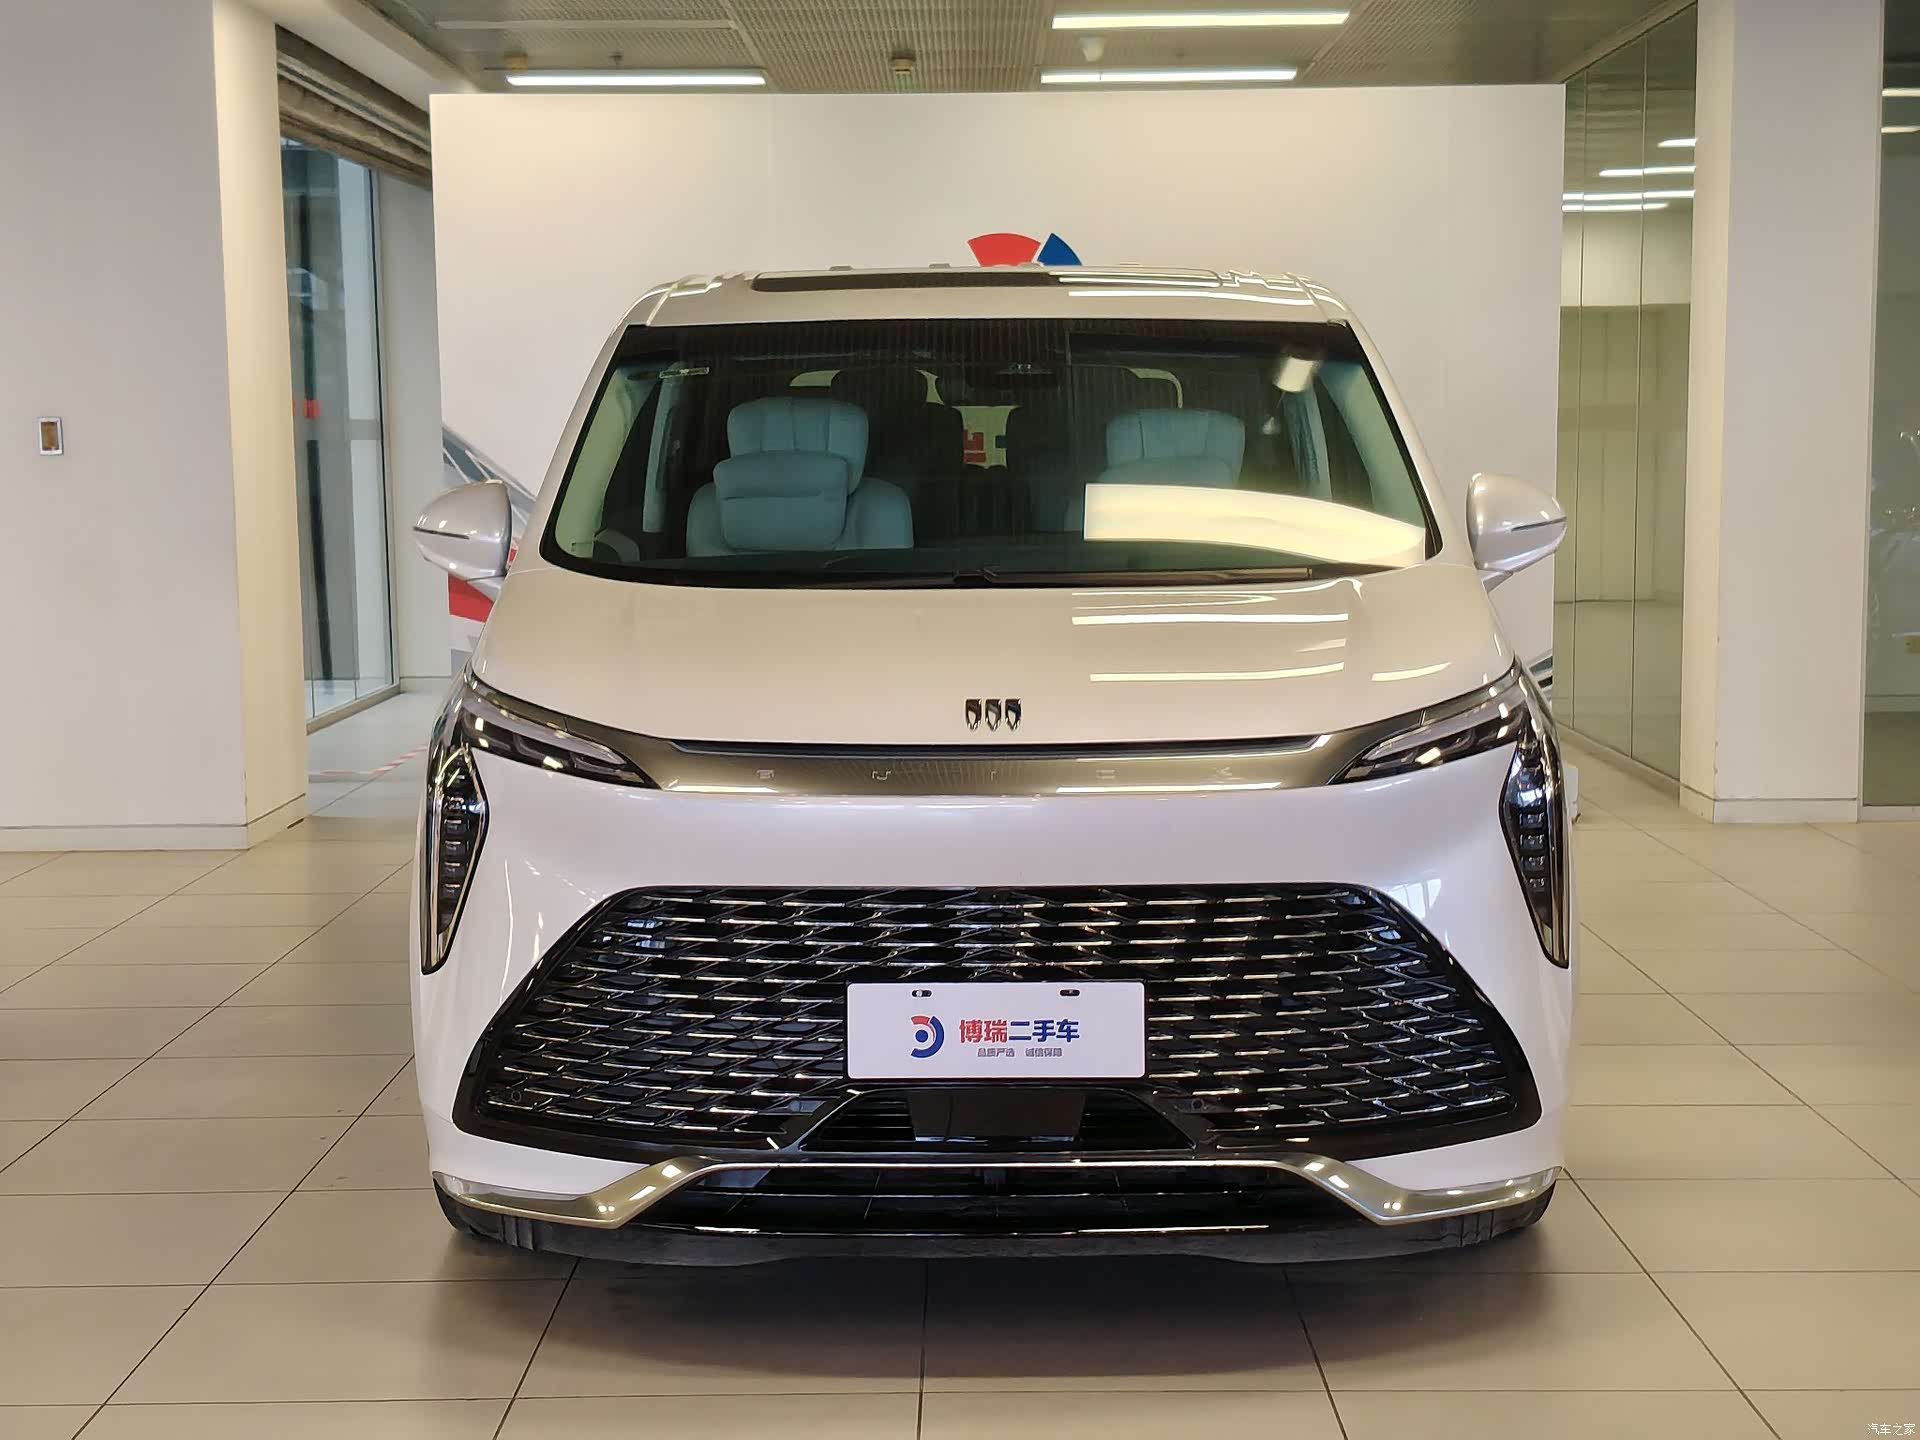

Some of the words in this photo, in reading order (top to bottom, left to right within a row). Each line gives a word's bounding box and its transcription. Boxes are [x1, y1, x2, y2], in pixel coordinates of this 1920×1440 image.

[959, 1018, 1081, 1043] 博瑞二手车
